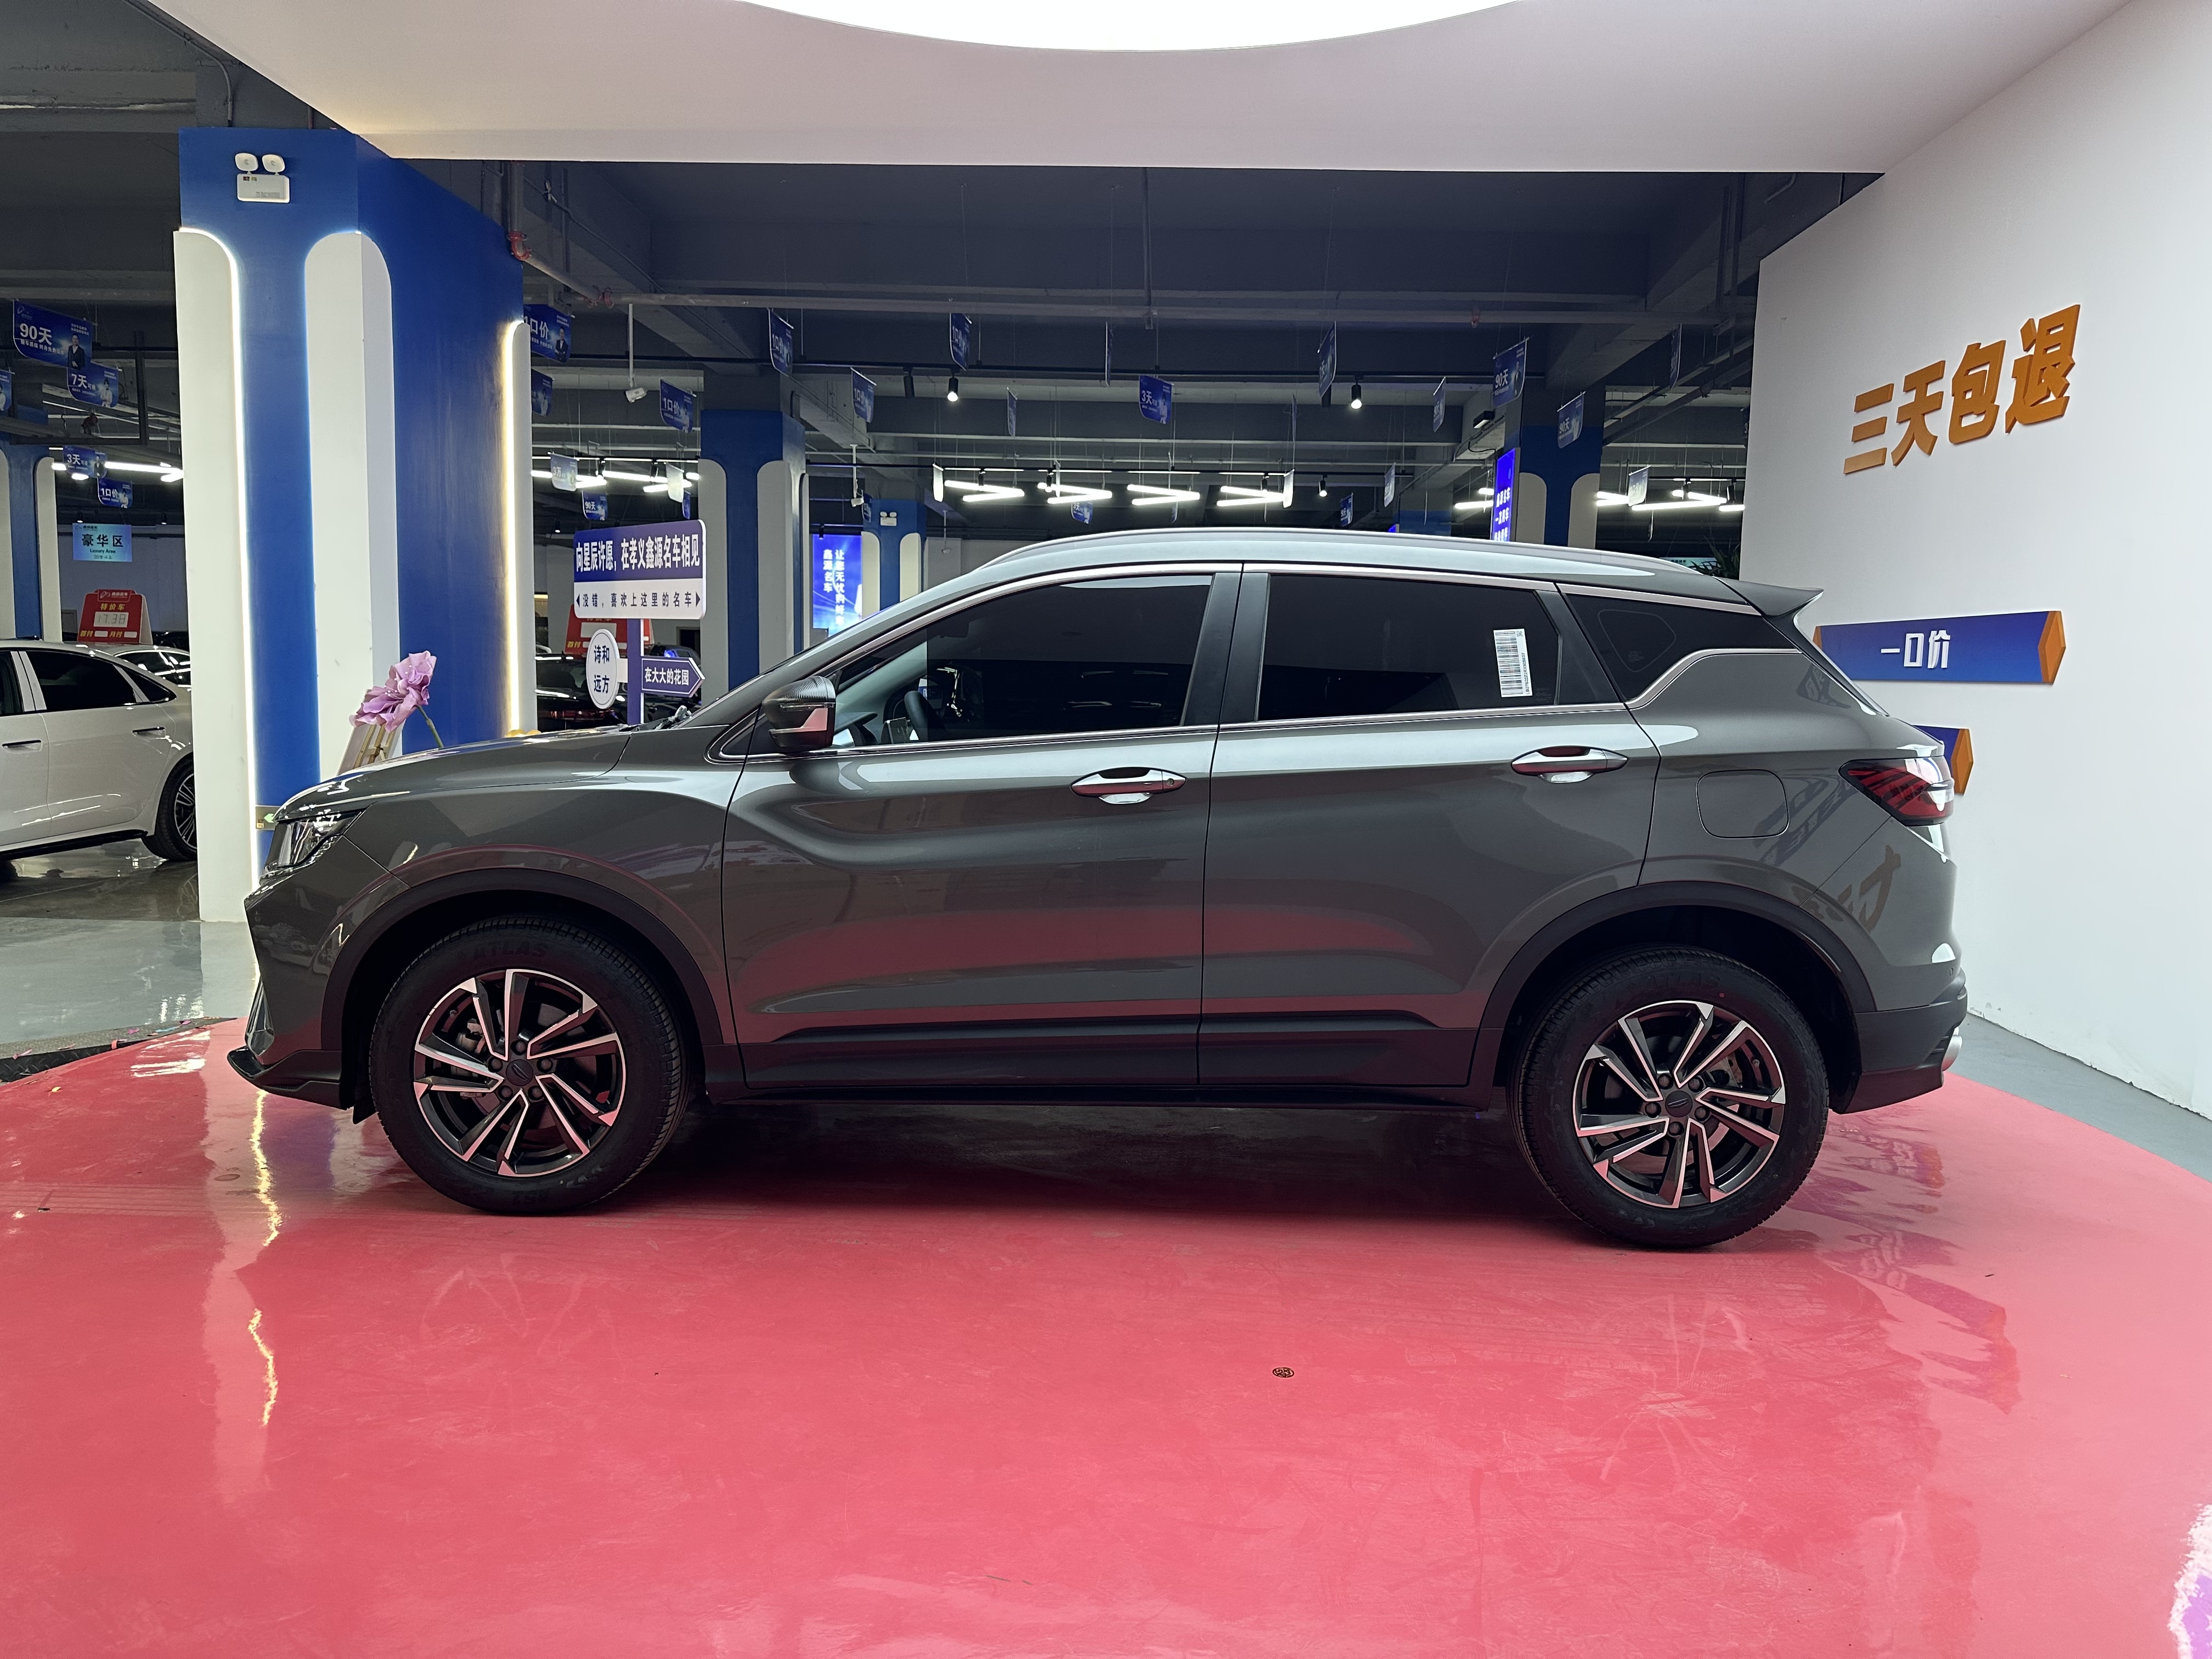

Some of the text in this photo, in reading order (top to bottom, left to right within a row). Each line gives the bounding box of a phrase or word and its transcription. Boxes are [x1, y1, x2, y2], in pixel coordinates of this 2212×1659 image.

[20, 323, 52, 346] 90天
[1495, 369, 1509, 388] 90天
[1843, 304, 2080, 474] 三天包退
[101, 488, 119, 499] 1口价
[82, 534, 123, 547] 豪华区
[98, 614, 126, 624] 17.38
[594, 645, 610, 664] 诗和
[1881, 629, 1950, 669] 一口价
[594, 674, 610, 693] 远方
[645, 667, 689, 686] 在大大的花园
[473, 940, 549, 960] ATLAS
